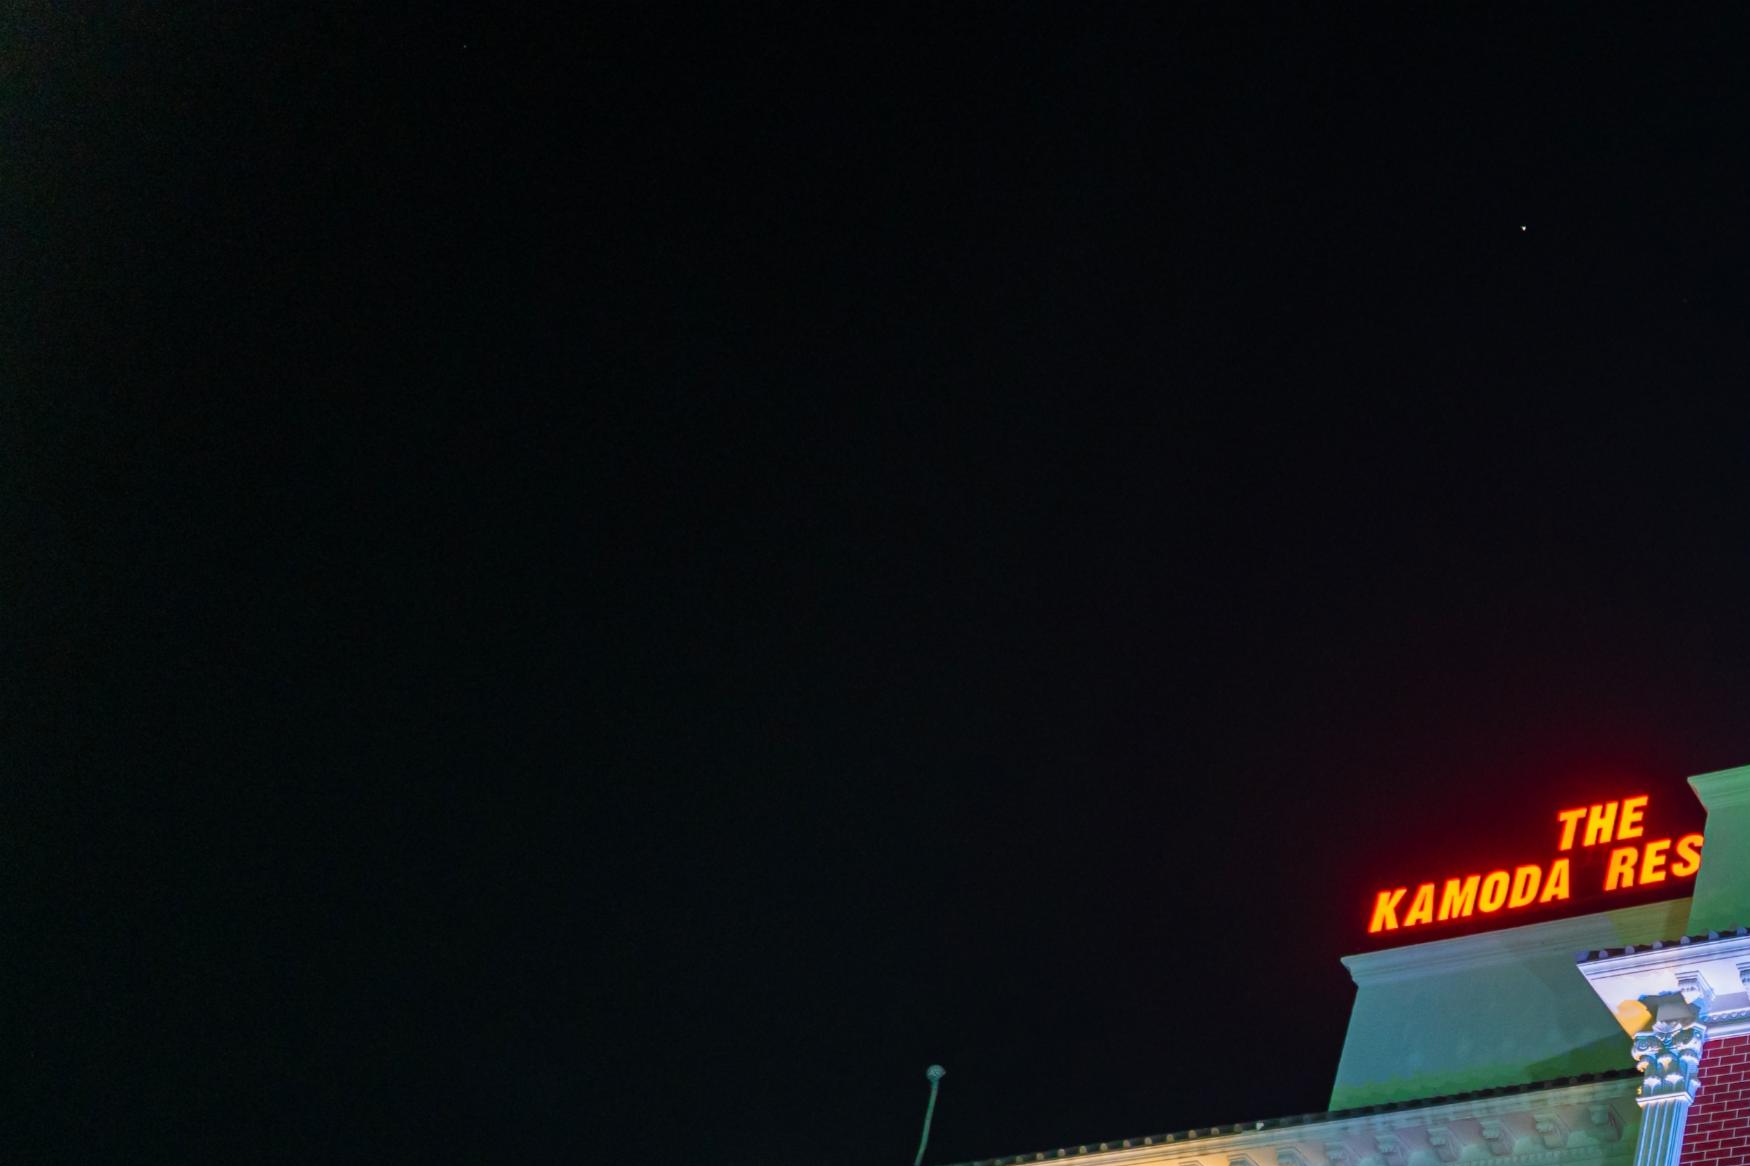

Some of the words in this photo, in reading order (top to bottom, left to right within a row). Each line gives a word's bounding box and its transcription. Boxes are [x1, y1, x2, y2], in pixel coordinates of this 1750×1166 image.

[1559, 795, 1648, 851] THE
[1368, 858, 1570, 933] KAMODA
[1604, 834, 1704, 891] RES
